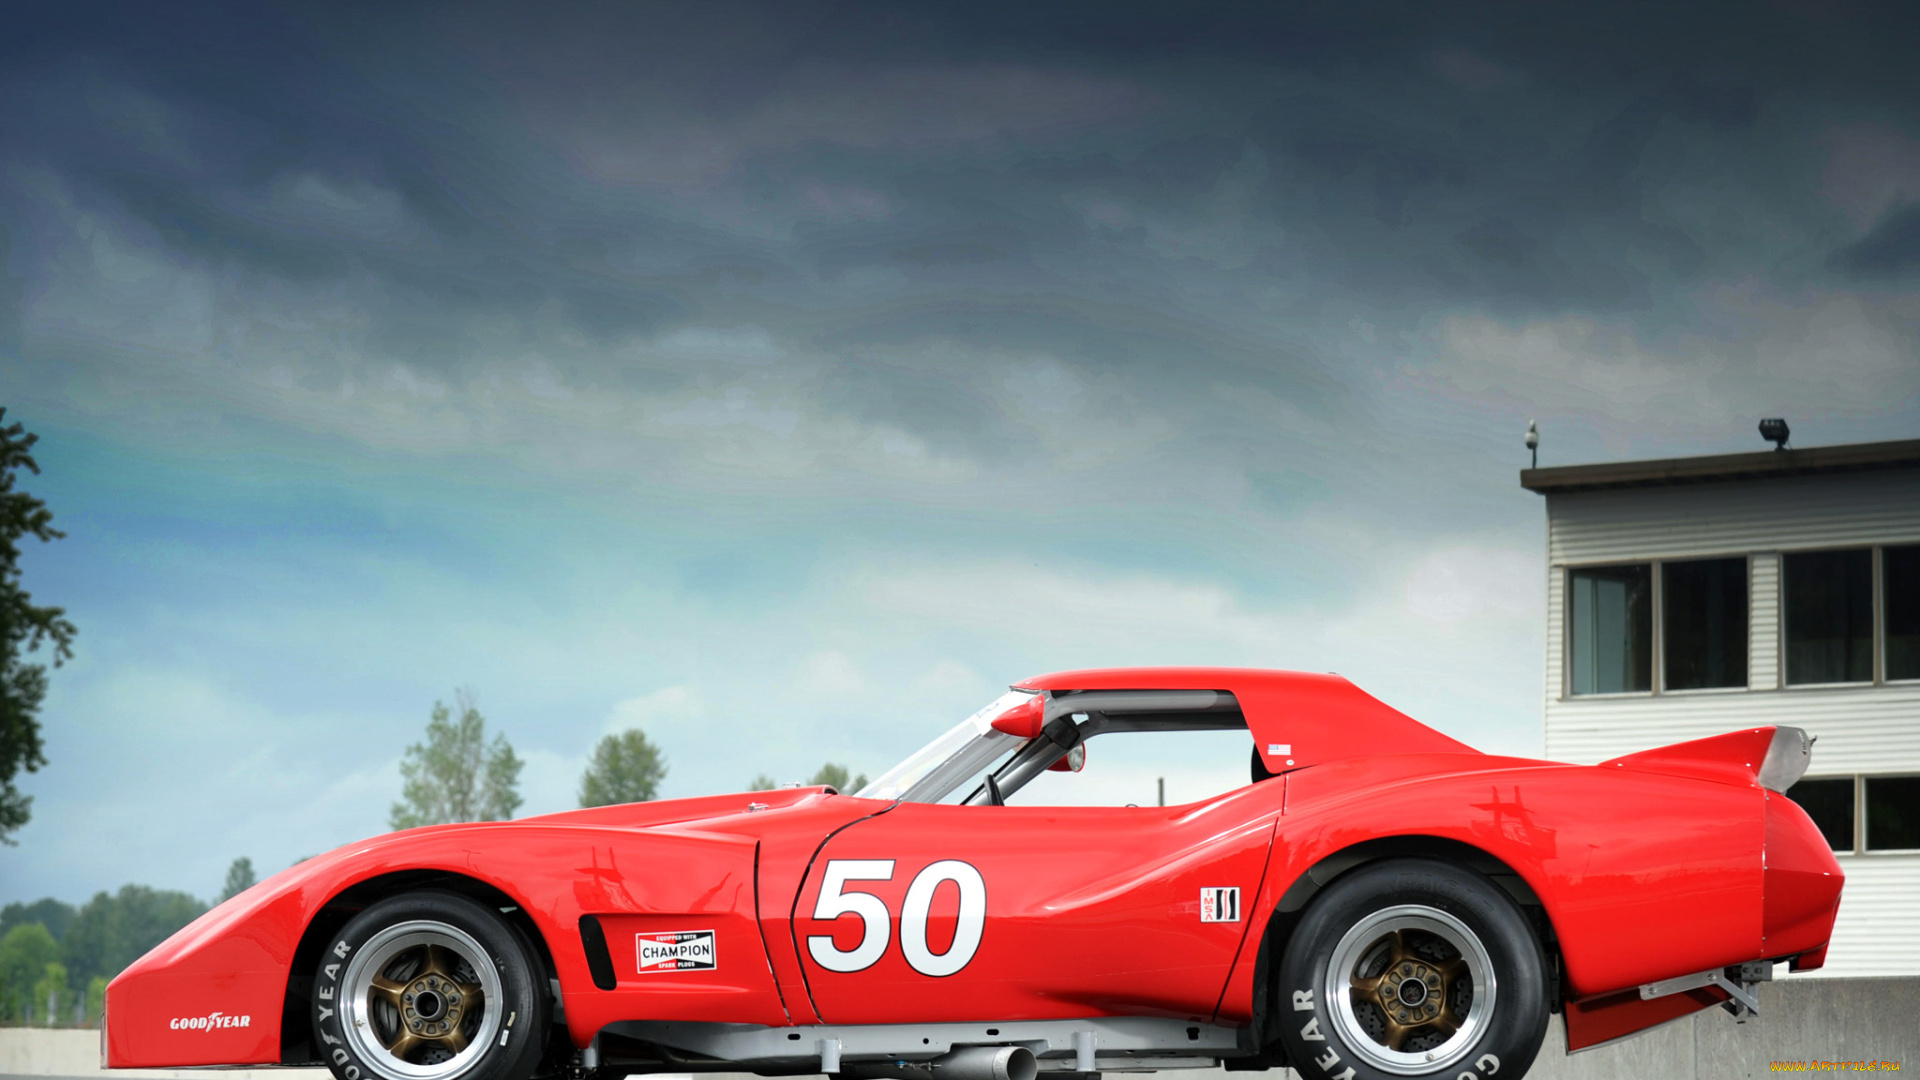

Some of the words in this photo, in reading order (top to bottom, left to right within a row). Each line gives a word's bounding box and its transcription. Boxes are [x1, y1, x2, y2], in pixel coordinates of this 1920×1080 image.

[807, 859, 987, 978] 50
[1204, 889, 1214, 921] IMSA
[642, 944, 710, 958] CHAMPION
[169, 1011, 251, 1033] GOODYEAR
